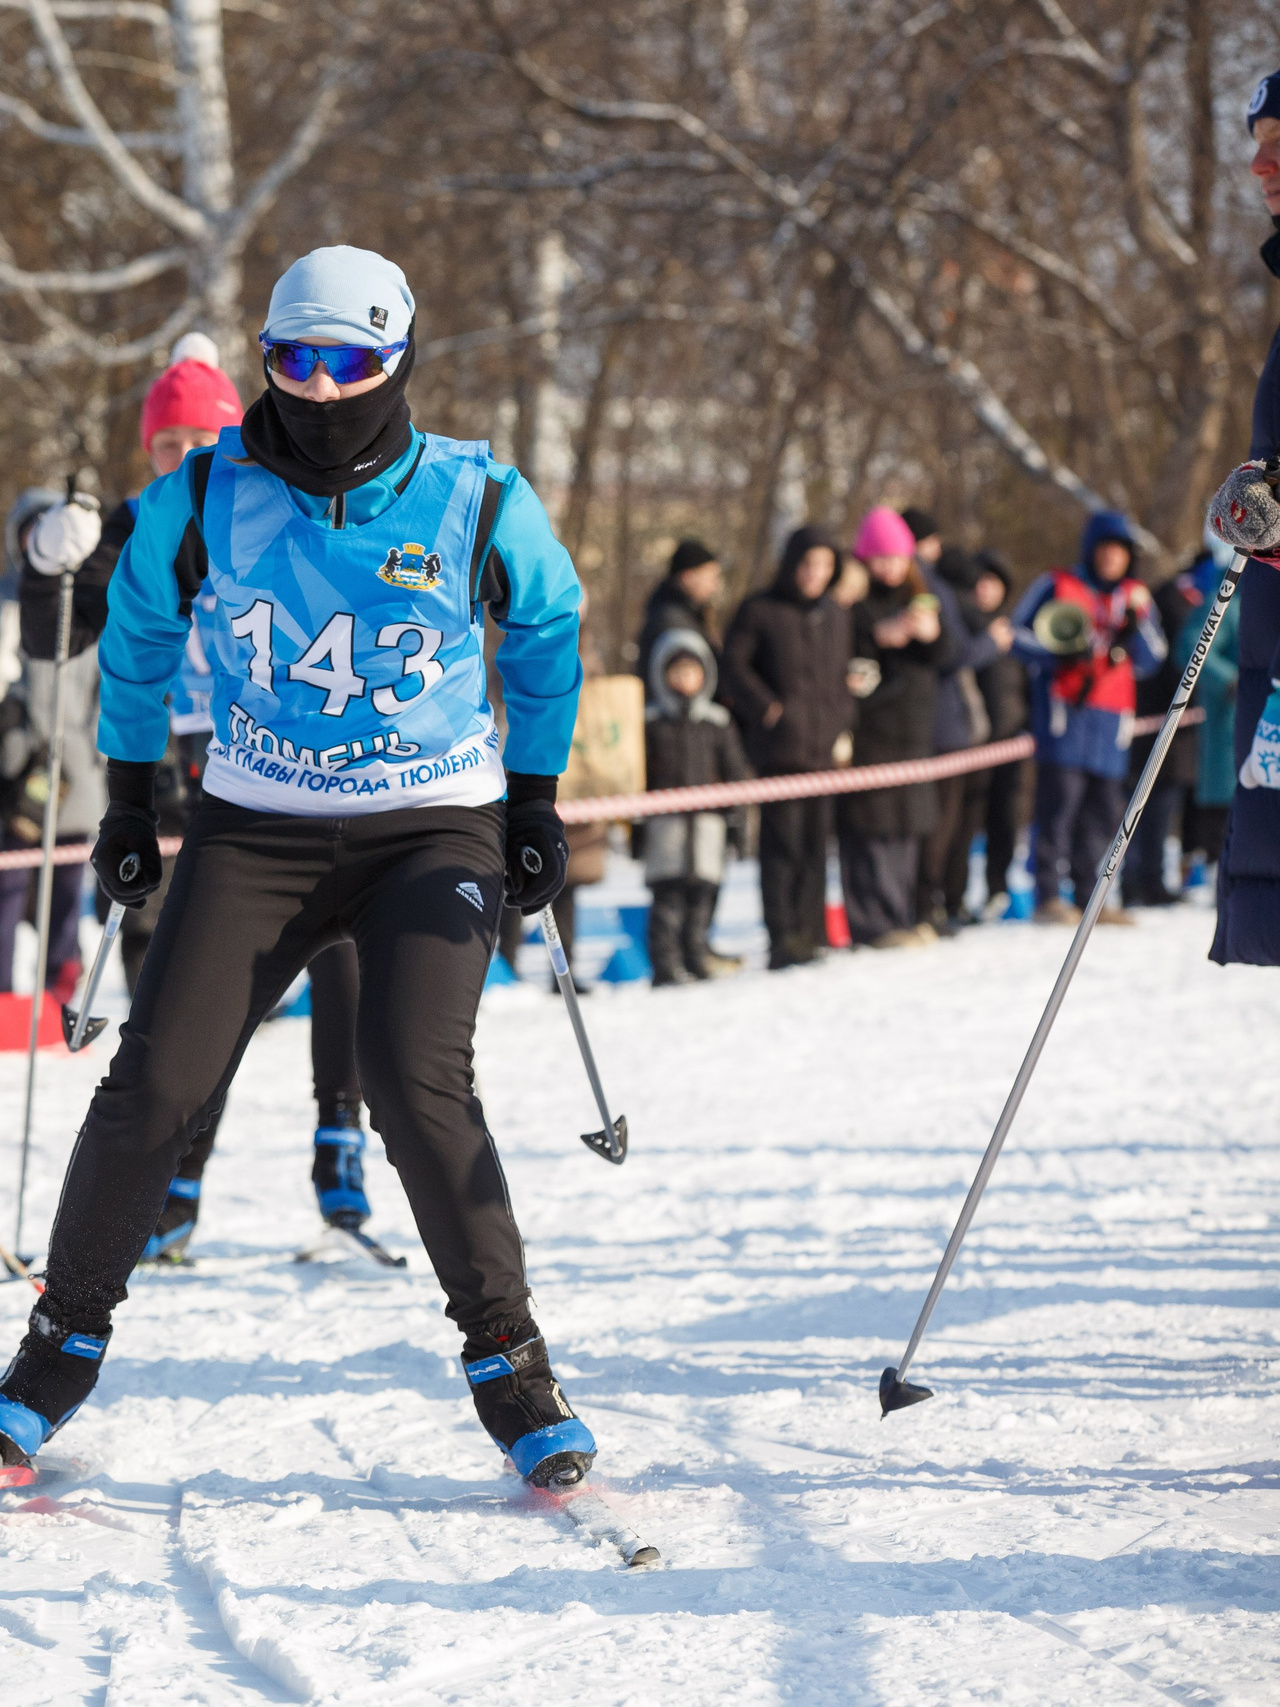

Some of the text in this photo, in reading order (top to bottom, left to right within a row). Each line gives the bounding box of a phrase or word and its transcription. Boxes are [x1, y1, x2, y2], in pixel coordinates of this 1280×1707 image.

[230, 598, 445, 718] 143
[1180, 605, 1222, 692] NORDWAY
[235, 747, 297, 785] ГЛАВЫ
[297, 770, 390, 796] ГОРОДА
[400, 746, 485, 790] ТЮМЕНИ
